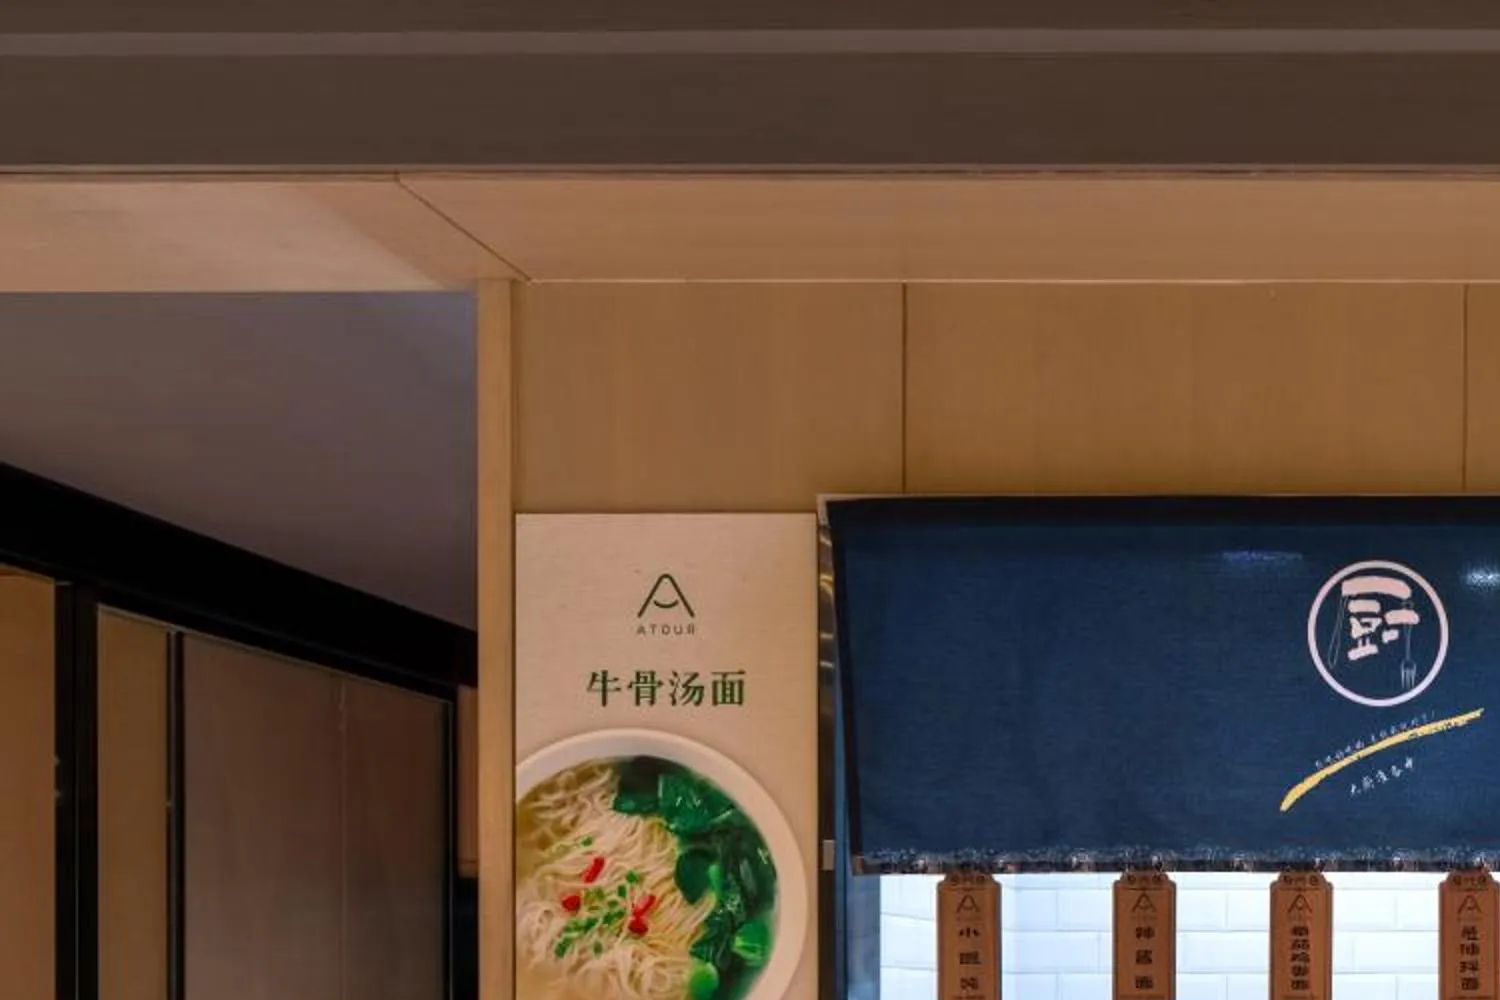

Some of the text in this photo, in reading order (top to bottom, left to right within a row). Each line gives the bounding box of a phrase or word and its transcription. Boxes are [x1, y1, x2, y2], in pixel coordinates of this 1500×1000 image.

[636, 623, 695, 636] ATOUR
[586, 669, 747, 707] 牛骨汤面
